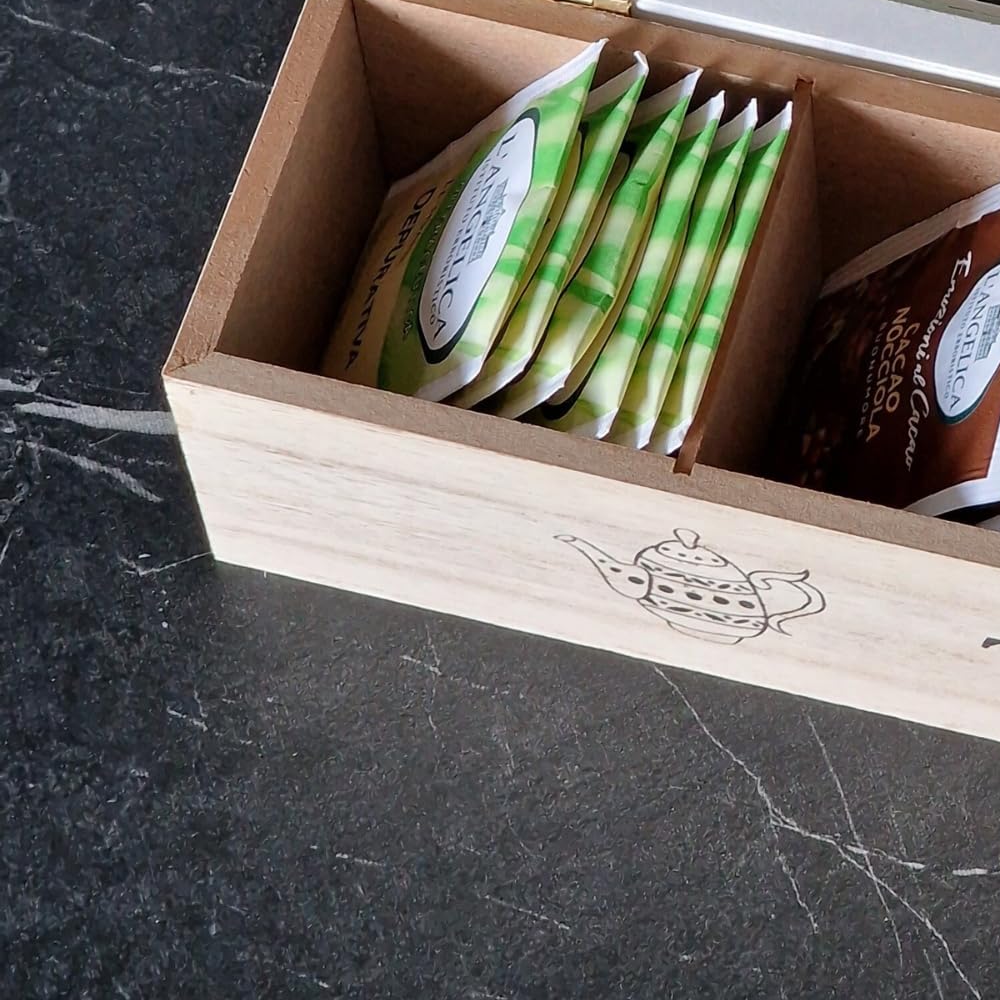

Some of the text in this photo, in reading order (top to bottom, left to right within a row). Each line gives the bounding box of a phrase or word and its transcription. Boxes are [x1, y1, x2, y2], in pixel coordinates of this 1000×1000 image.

[346, 186, 436, 369] DEPURATIVA
[433, 134, 516, 341] L'ANGELICA
[866, 306, 911, 442] NOCCIOLA
[885, 322, 920, 413] CACAO
[905, 250, 972, 472] Emozioni al Cacao
[949, 271, 1000, 410] L'ANGELICA
